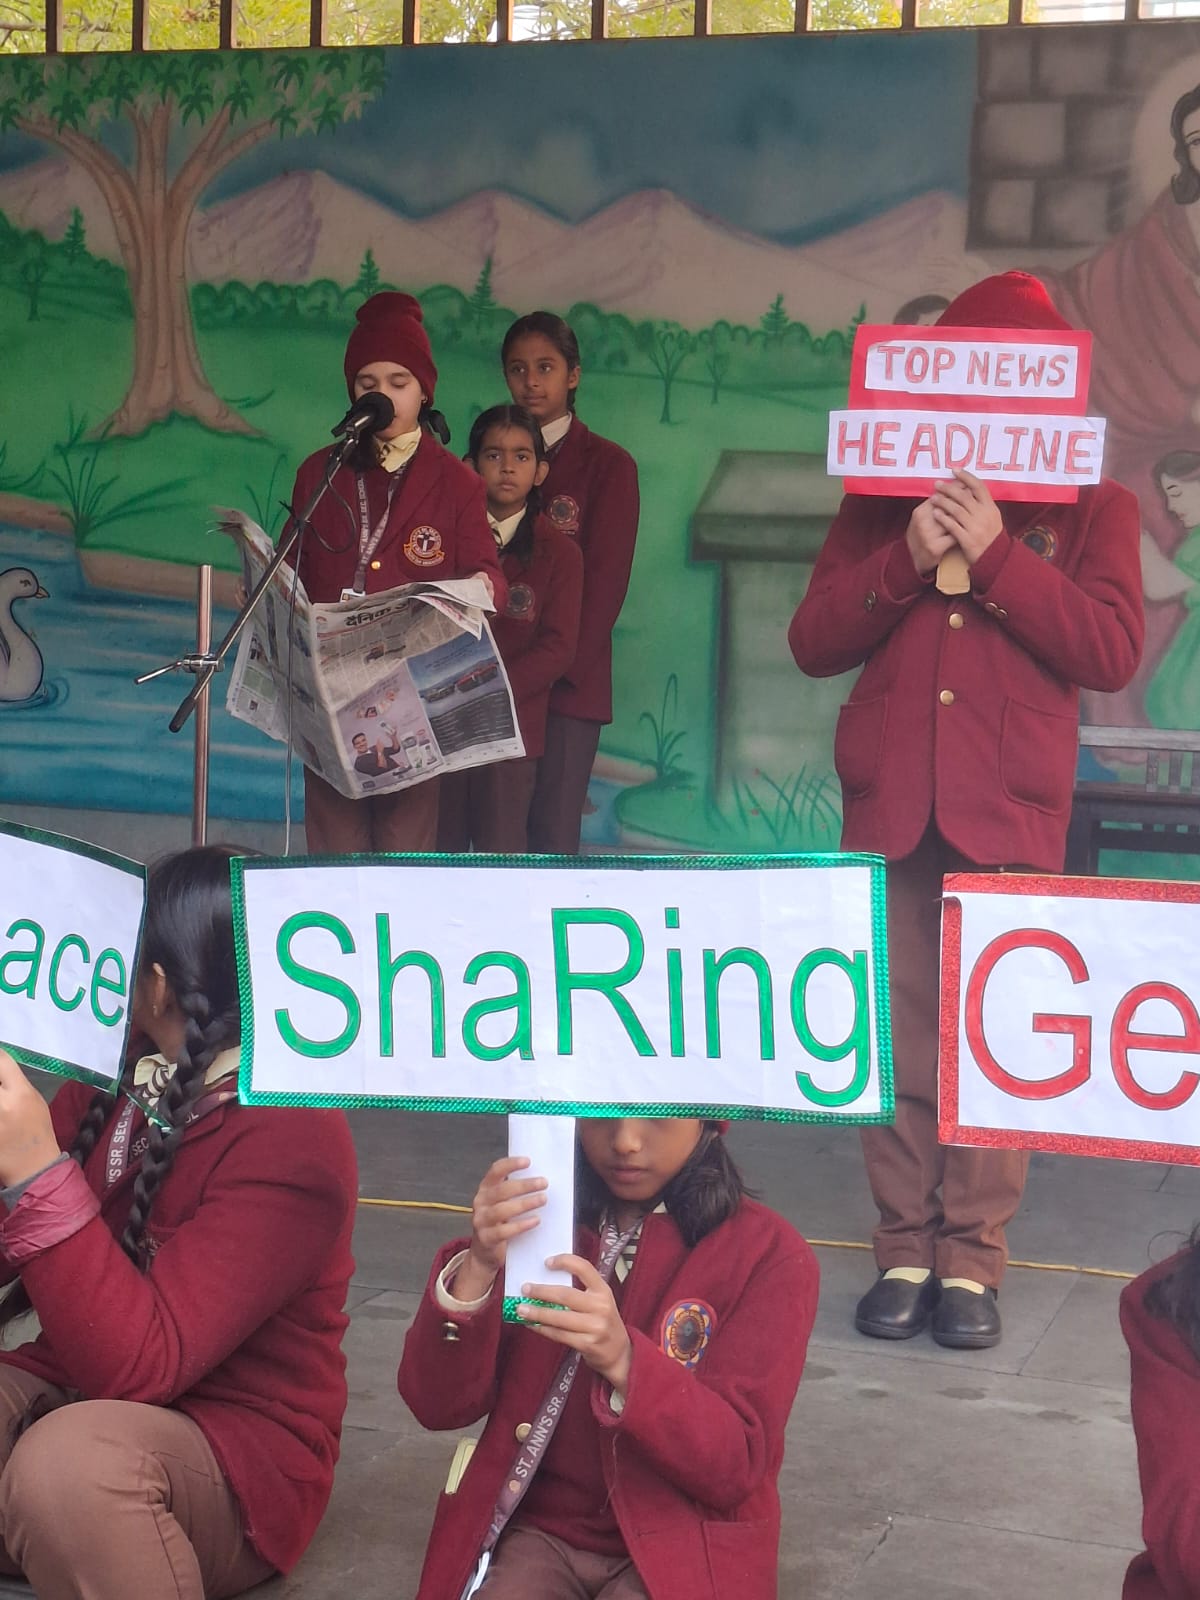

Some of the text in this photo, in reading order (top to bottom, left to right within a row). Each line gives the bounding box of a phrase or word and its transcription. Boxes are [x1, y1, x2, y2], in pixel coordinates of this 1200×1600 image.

[877, 345, 1069, 387] TOP NEWS
[837, 420, 1097, 475] HEADLINE
[273, 906, 871, 1109] ShaRing
[110, 1146, 123, 1166] SR.
[515, 1365, 578, 1478] ST. ANN'S SR. SEC.
